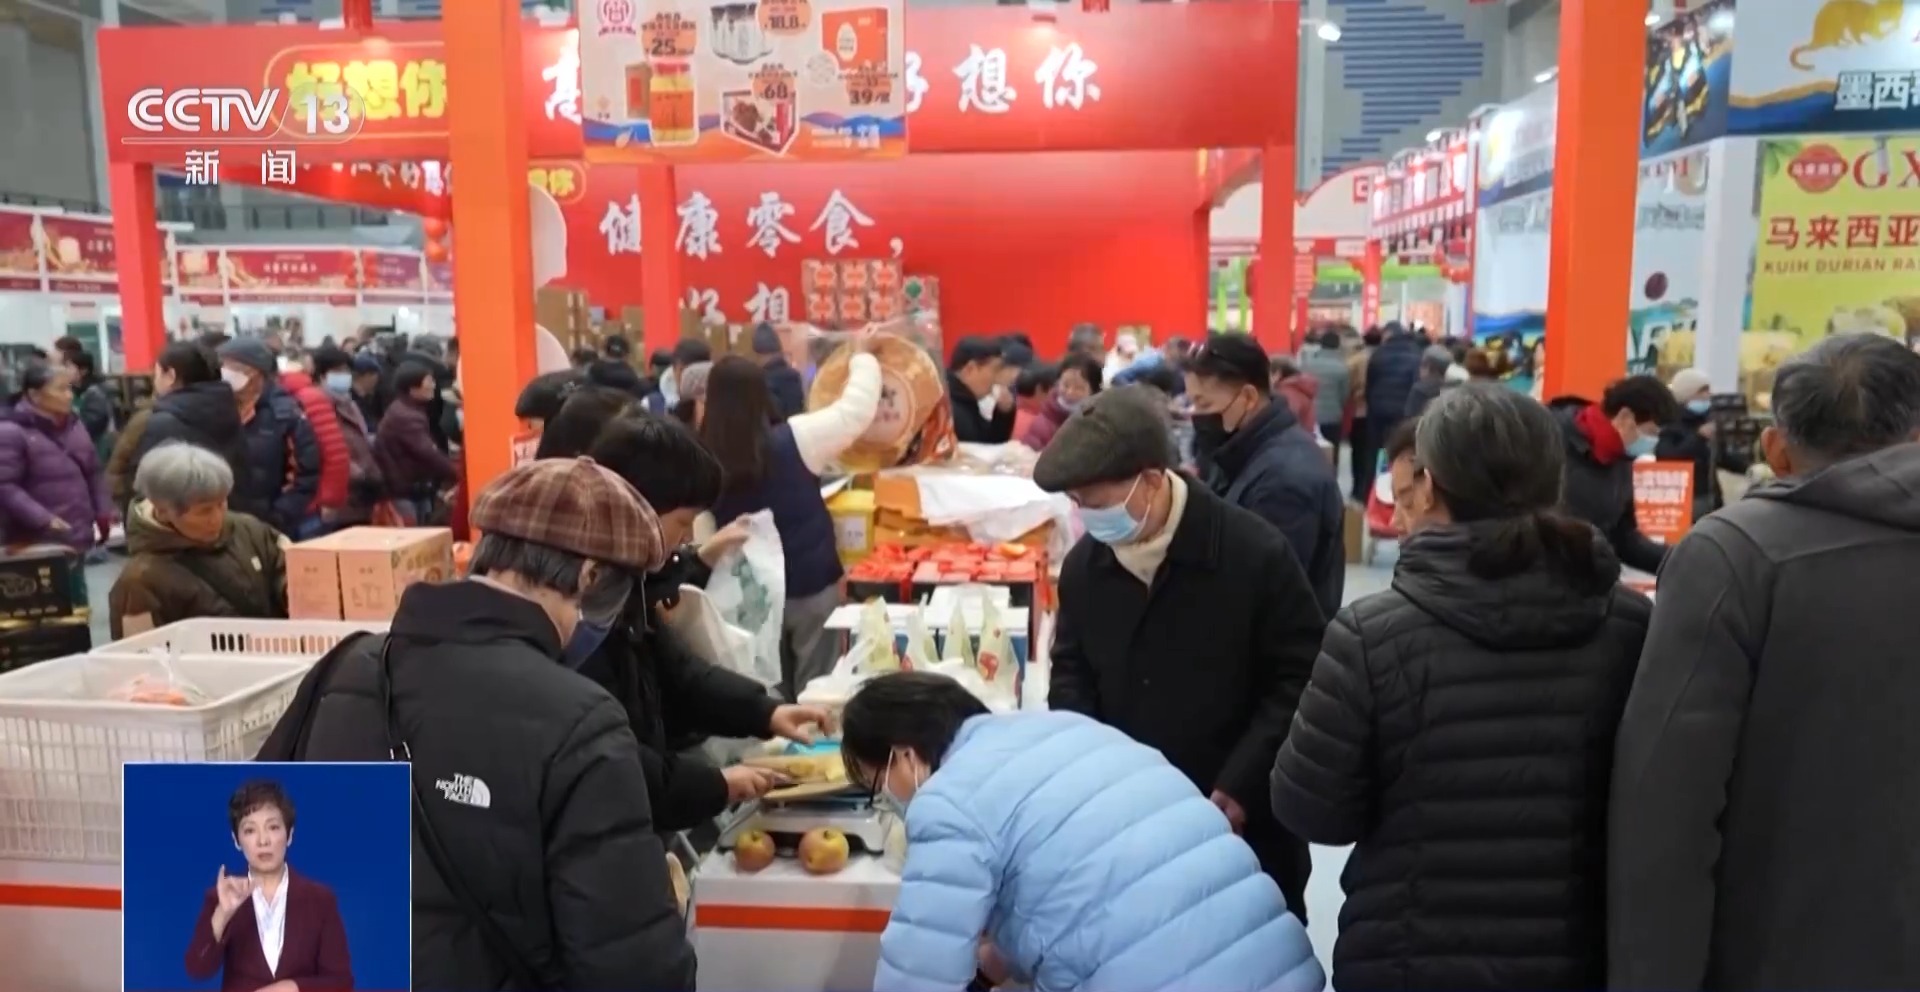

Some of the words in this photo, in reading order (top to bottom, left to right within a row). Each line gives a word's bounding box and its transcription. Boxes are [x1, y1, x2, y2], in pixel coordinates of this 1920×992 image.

[1766, 214, 1920, 250] 马来西亚
[1815, 257, 1886, 272] DURIAN
